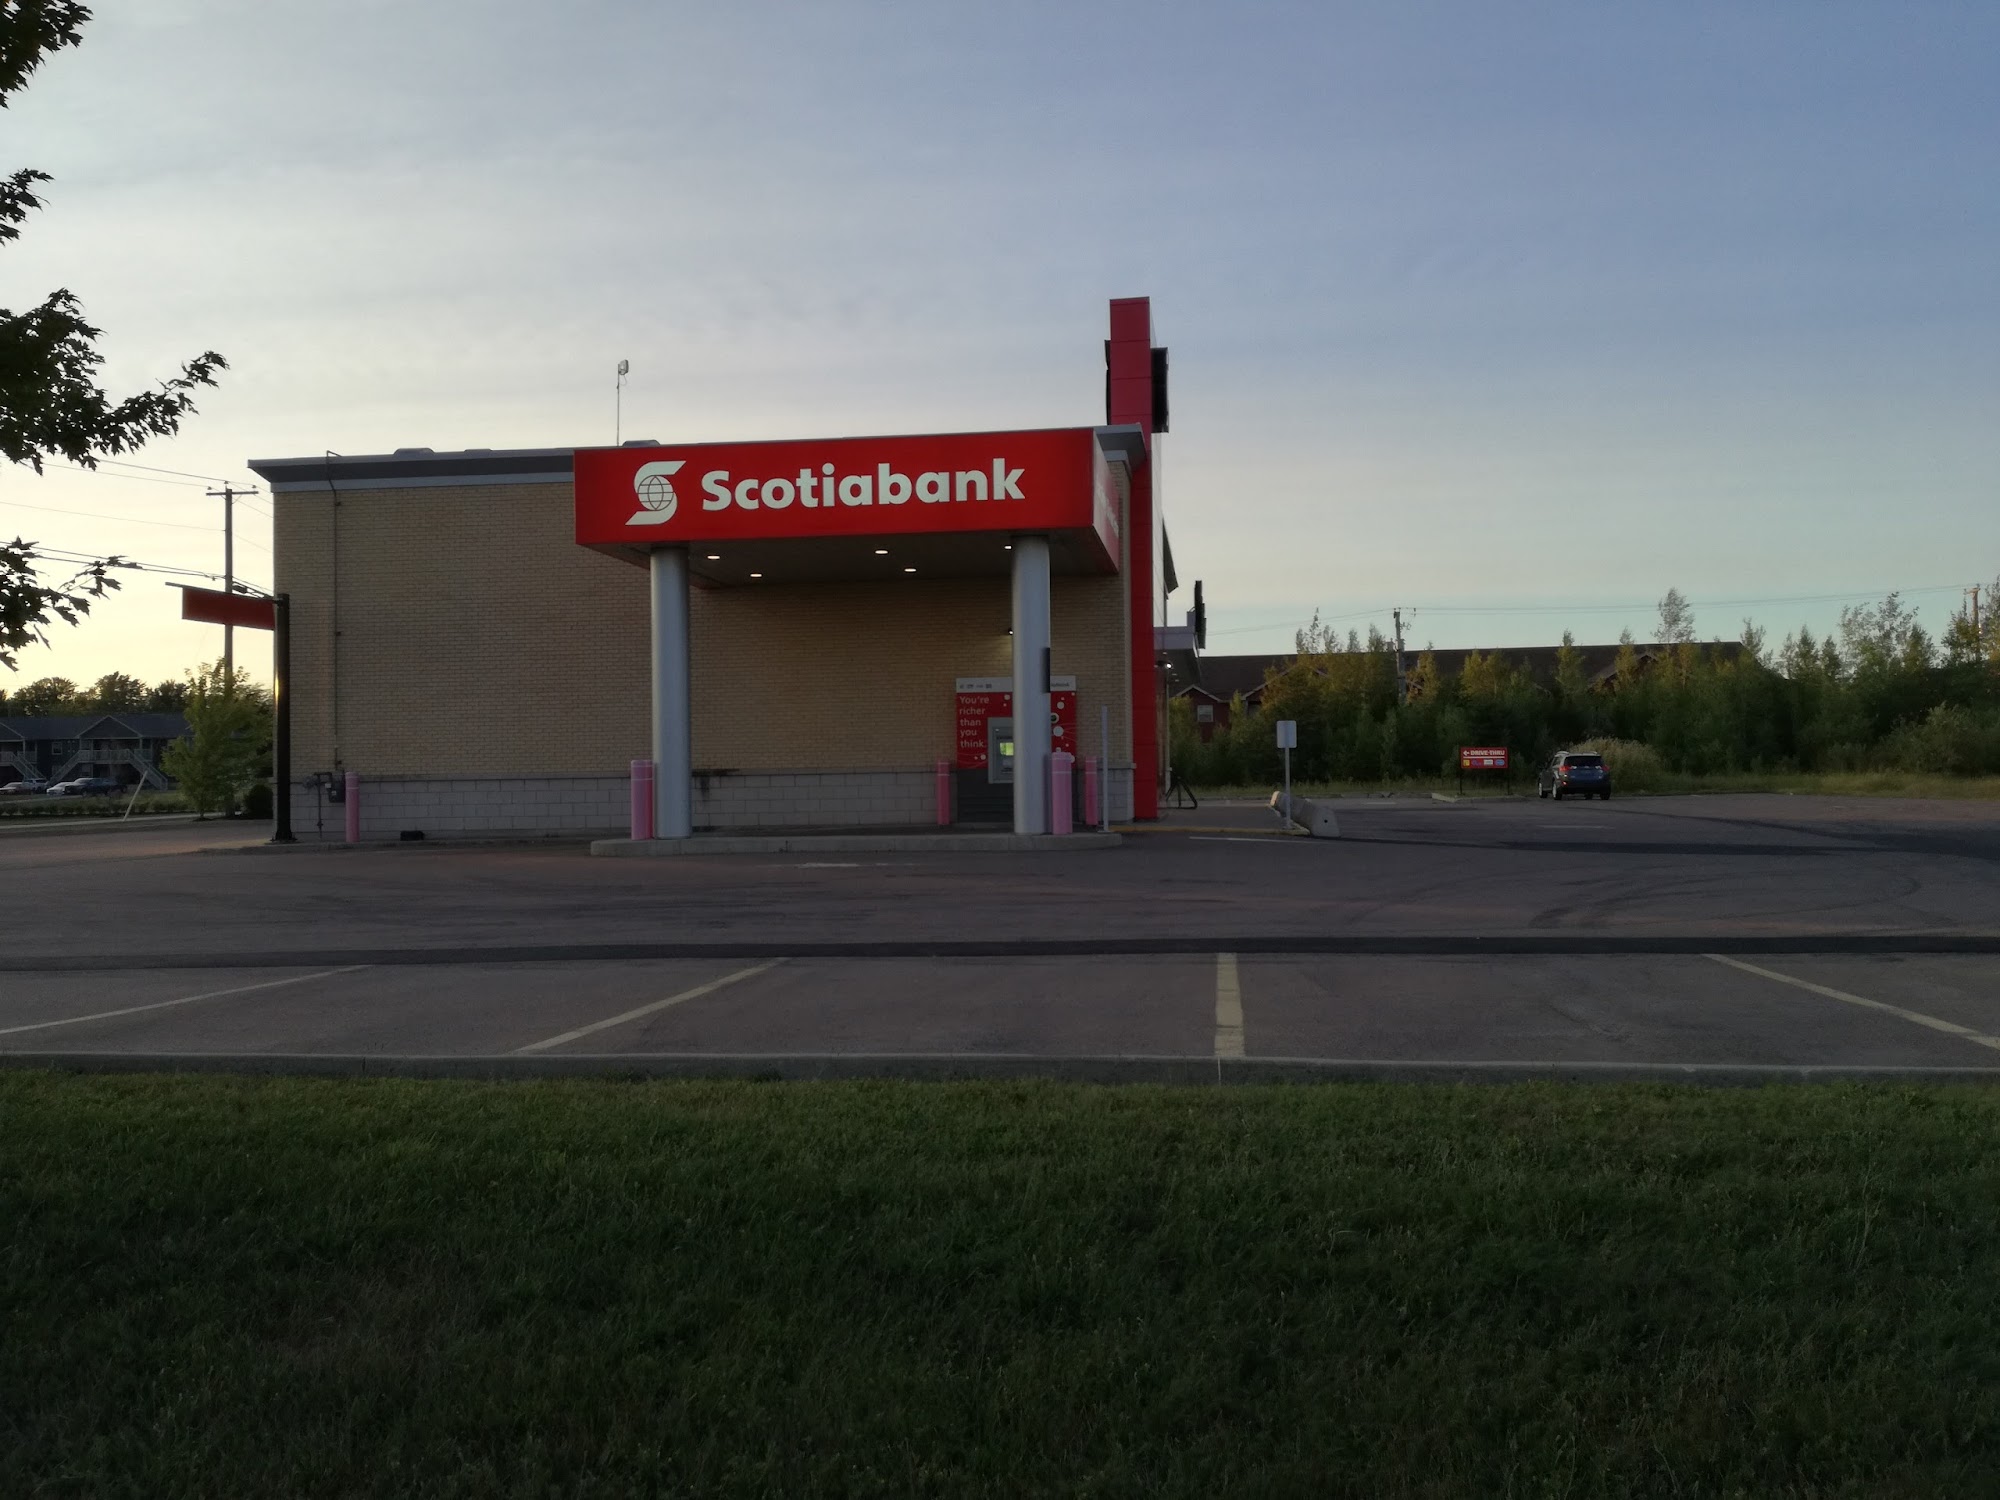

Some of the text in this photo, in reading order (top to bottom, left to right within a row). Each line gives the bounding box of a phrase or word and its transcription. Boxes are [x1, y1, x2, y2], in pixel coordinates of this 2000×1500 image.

[701, 457, 1026, 511] Scotiabank
[960, 696, 990, 704] You're
[960, 707, 986, 715] richer
[960, 718, 982, 726] than
[960, 729, 977, 738] you
